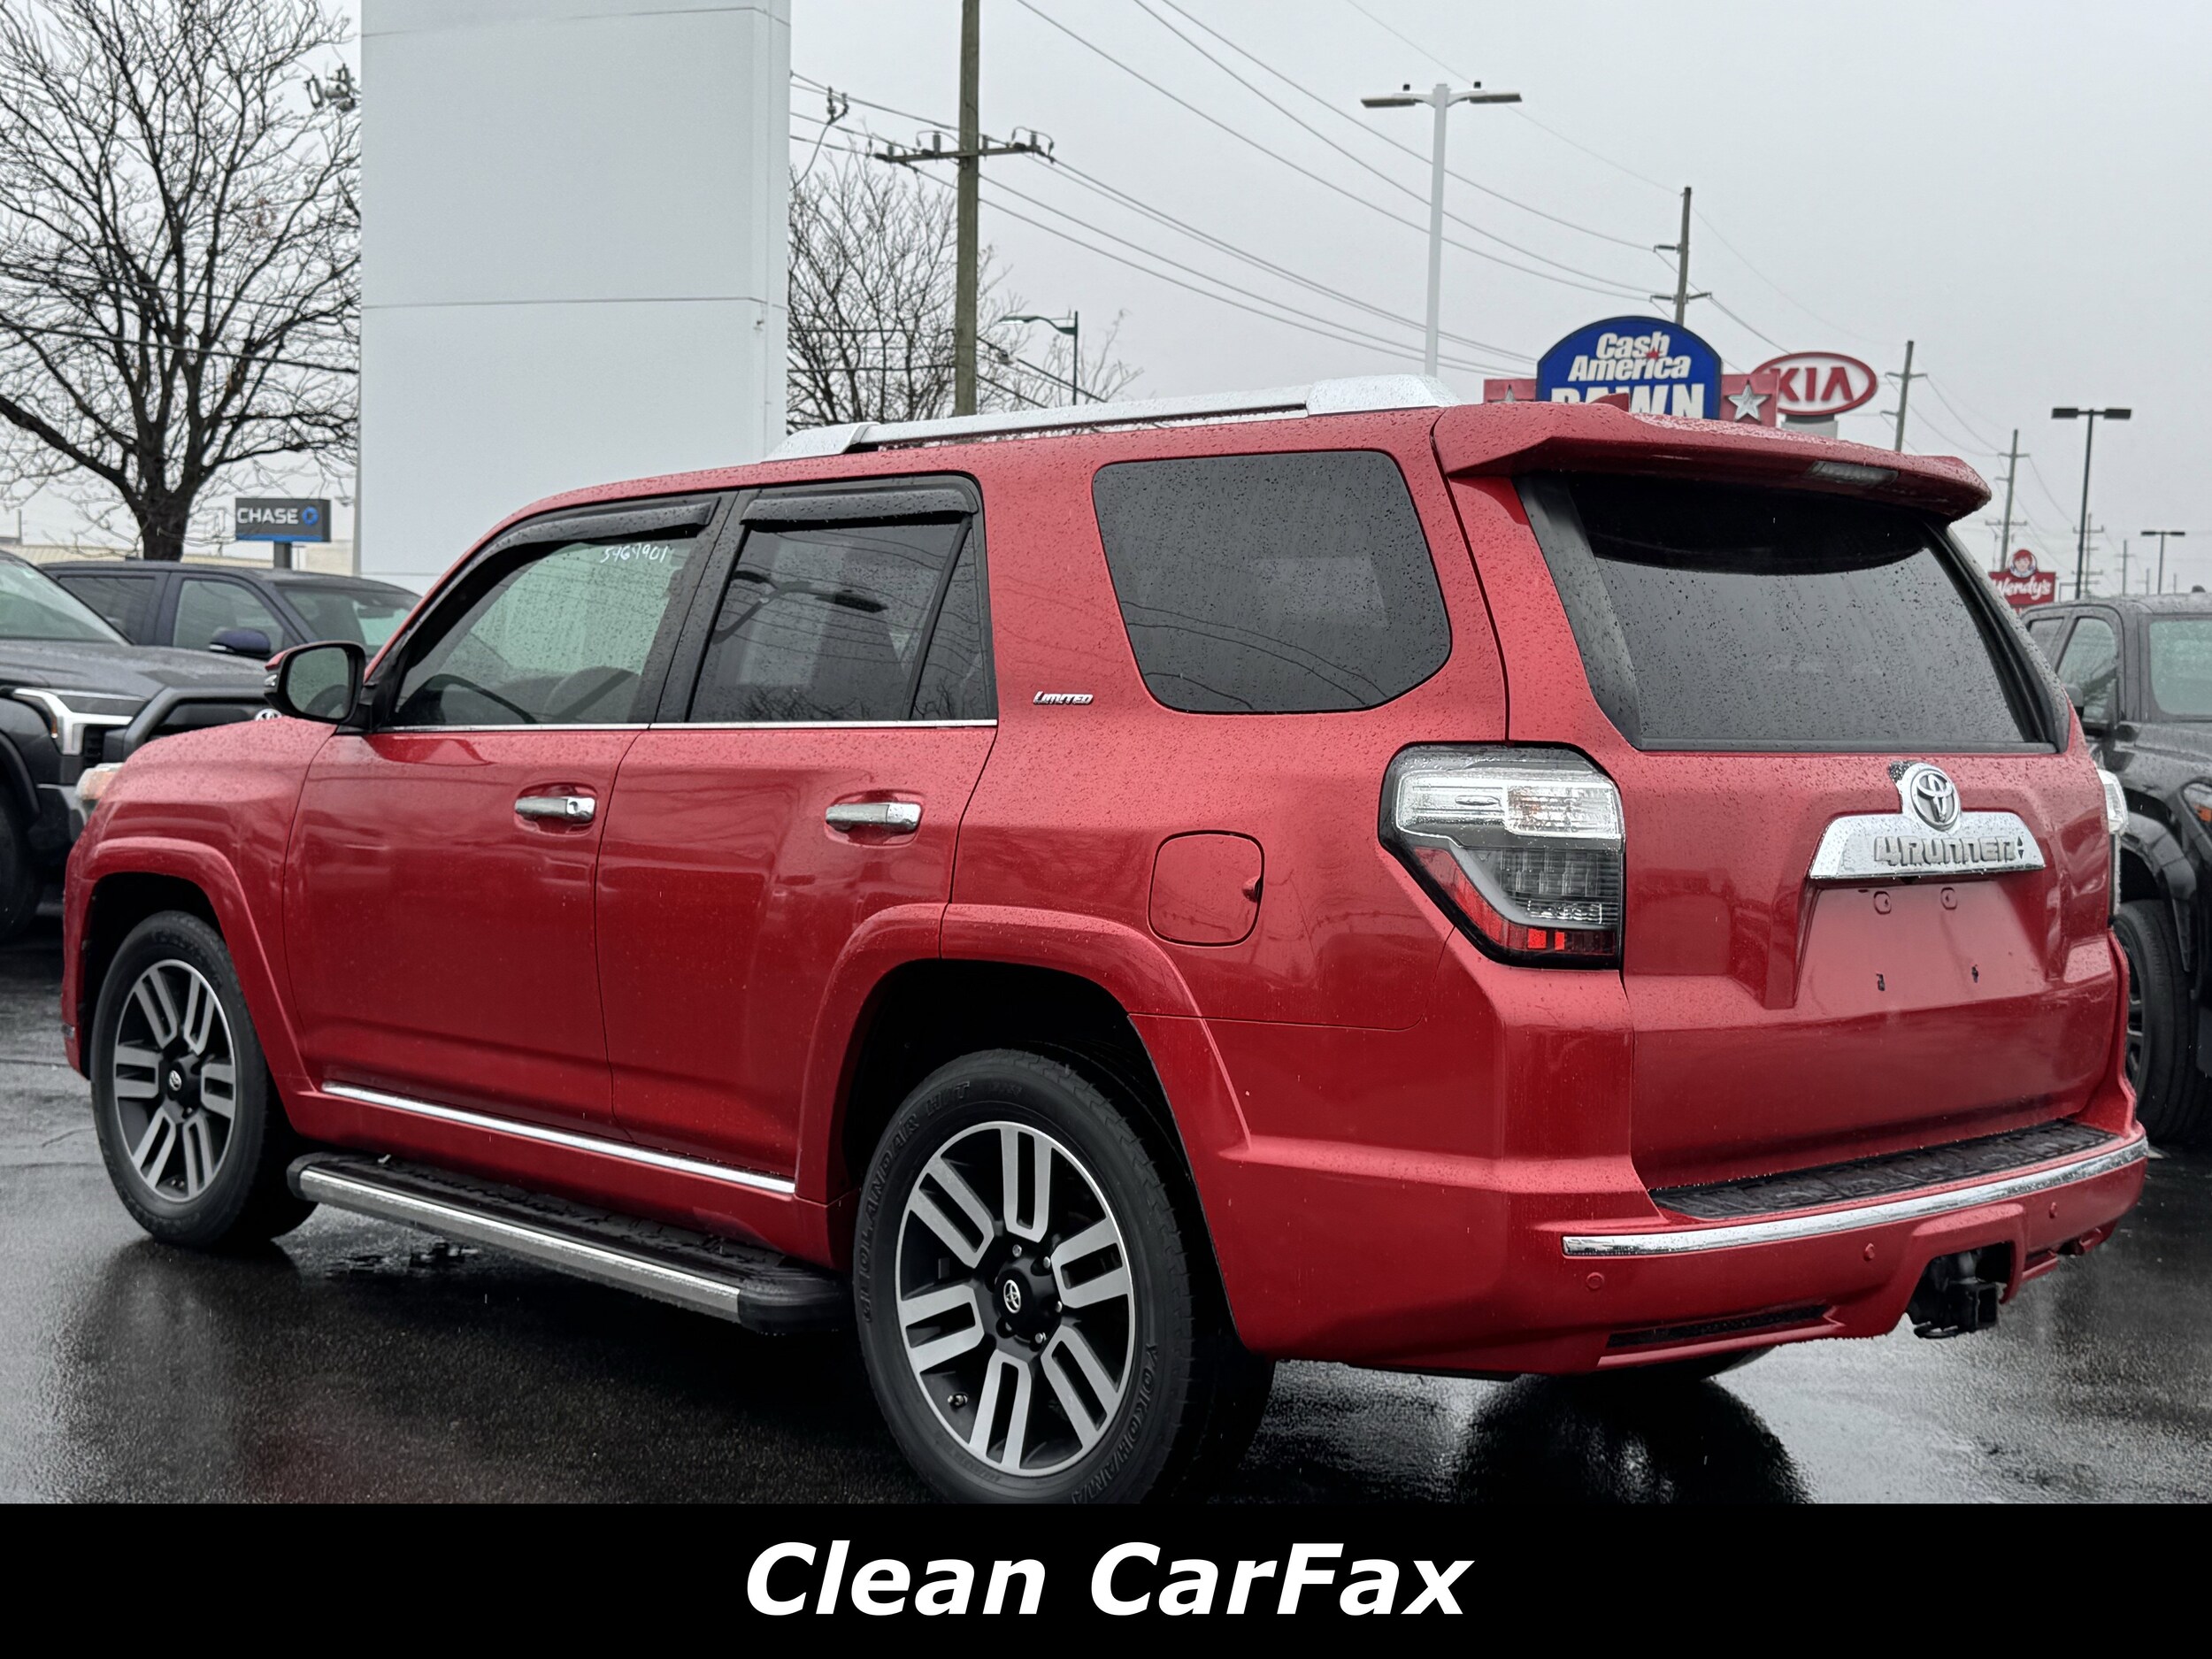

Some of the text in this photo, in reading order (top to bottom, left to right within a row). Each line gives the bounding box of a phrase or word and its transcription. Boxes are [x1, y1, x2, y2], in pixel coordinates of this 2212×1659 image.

[1596, 331, 1671, 360] Cash
[1567, 355, 1692, 382] America
[1770, 366, 1855, 403] KIA
[237, 507, 299, 525] CHASE
[1992, 575, 2053, 601] Wendy's
[1071, 1342, 1158, 1504] YOKOHAMA
